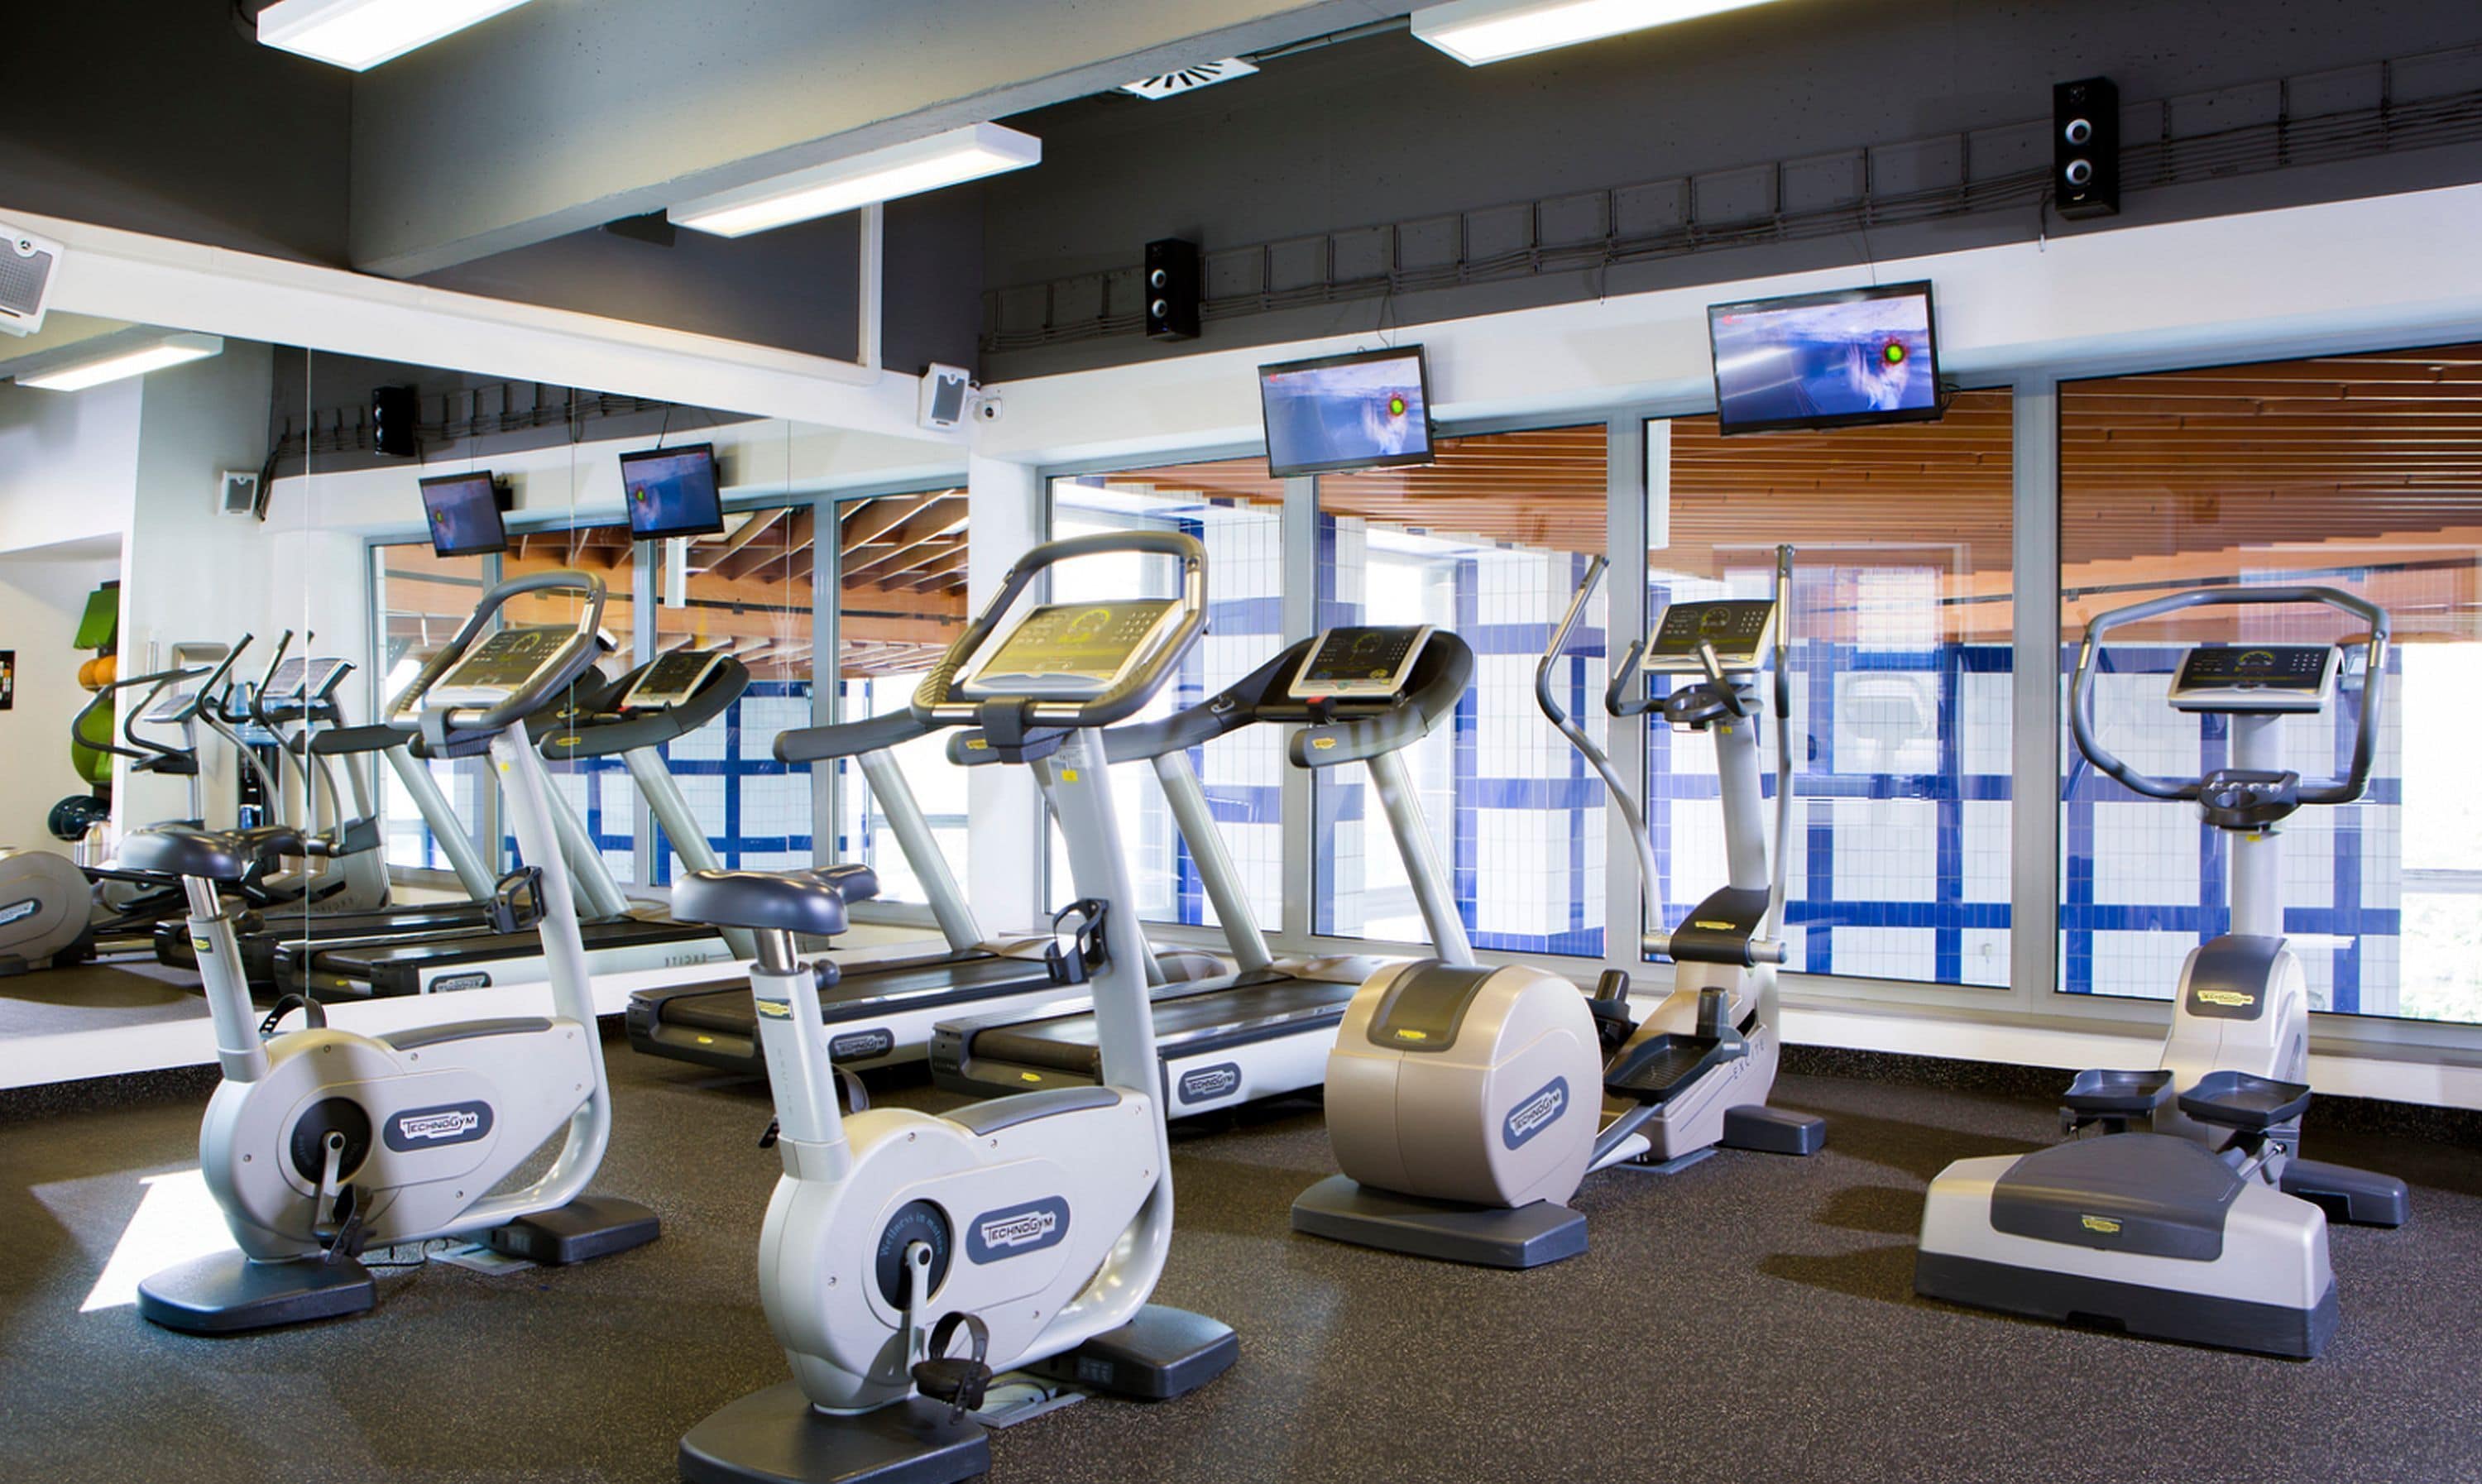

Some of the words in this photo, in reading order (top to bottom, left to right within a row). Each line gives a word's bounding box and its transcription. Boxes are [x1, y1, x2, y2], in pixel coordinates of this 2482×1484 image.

[400, 1113, 477, 1137] TECHNOGYM
[1511, 1090, 1561, 1133] TECHNOGYM
[879, 1213, 913, 1257] Wellness
[916, 1211, 926, 1224] in
[982, 1214, 1055, 1245] TECHNOGYM
